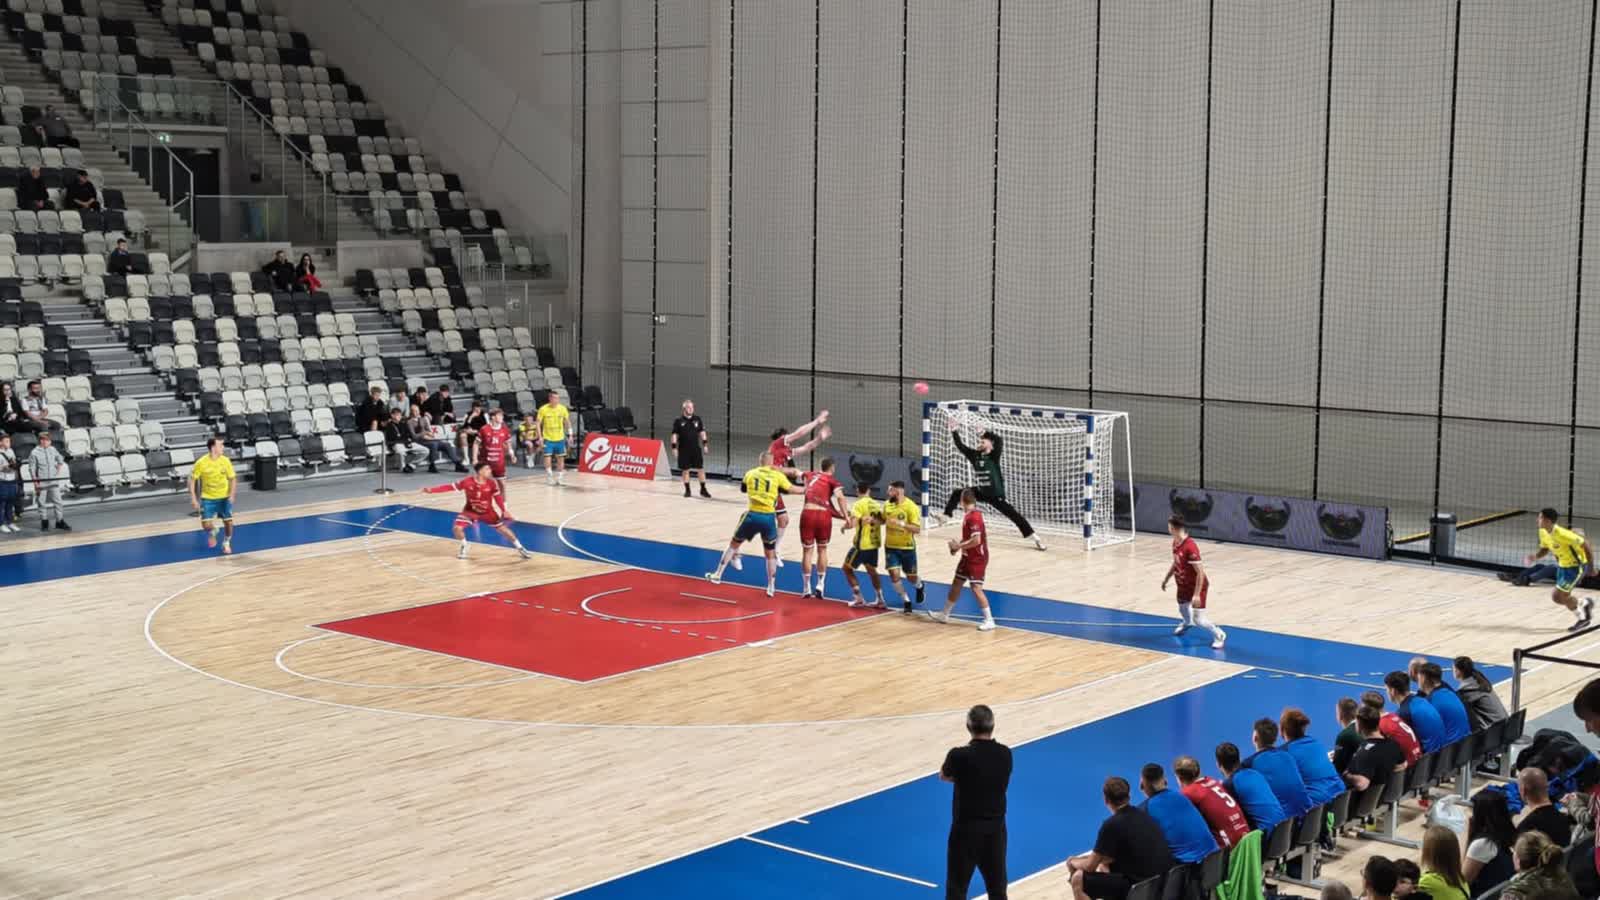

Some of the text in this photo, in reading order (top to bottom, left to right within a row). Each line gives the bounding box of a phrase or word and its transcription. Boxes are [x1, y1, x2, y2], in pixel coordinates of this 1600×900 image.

[614, 444, 630, 453] LIGA
[612, 453, 653, 465] CENTRALNA
[754, 478, 770, 492] 11
[1399, 721, 1416, 742] 9
[1211, 786, 1236, 808] 5
